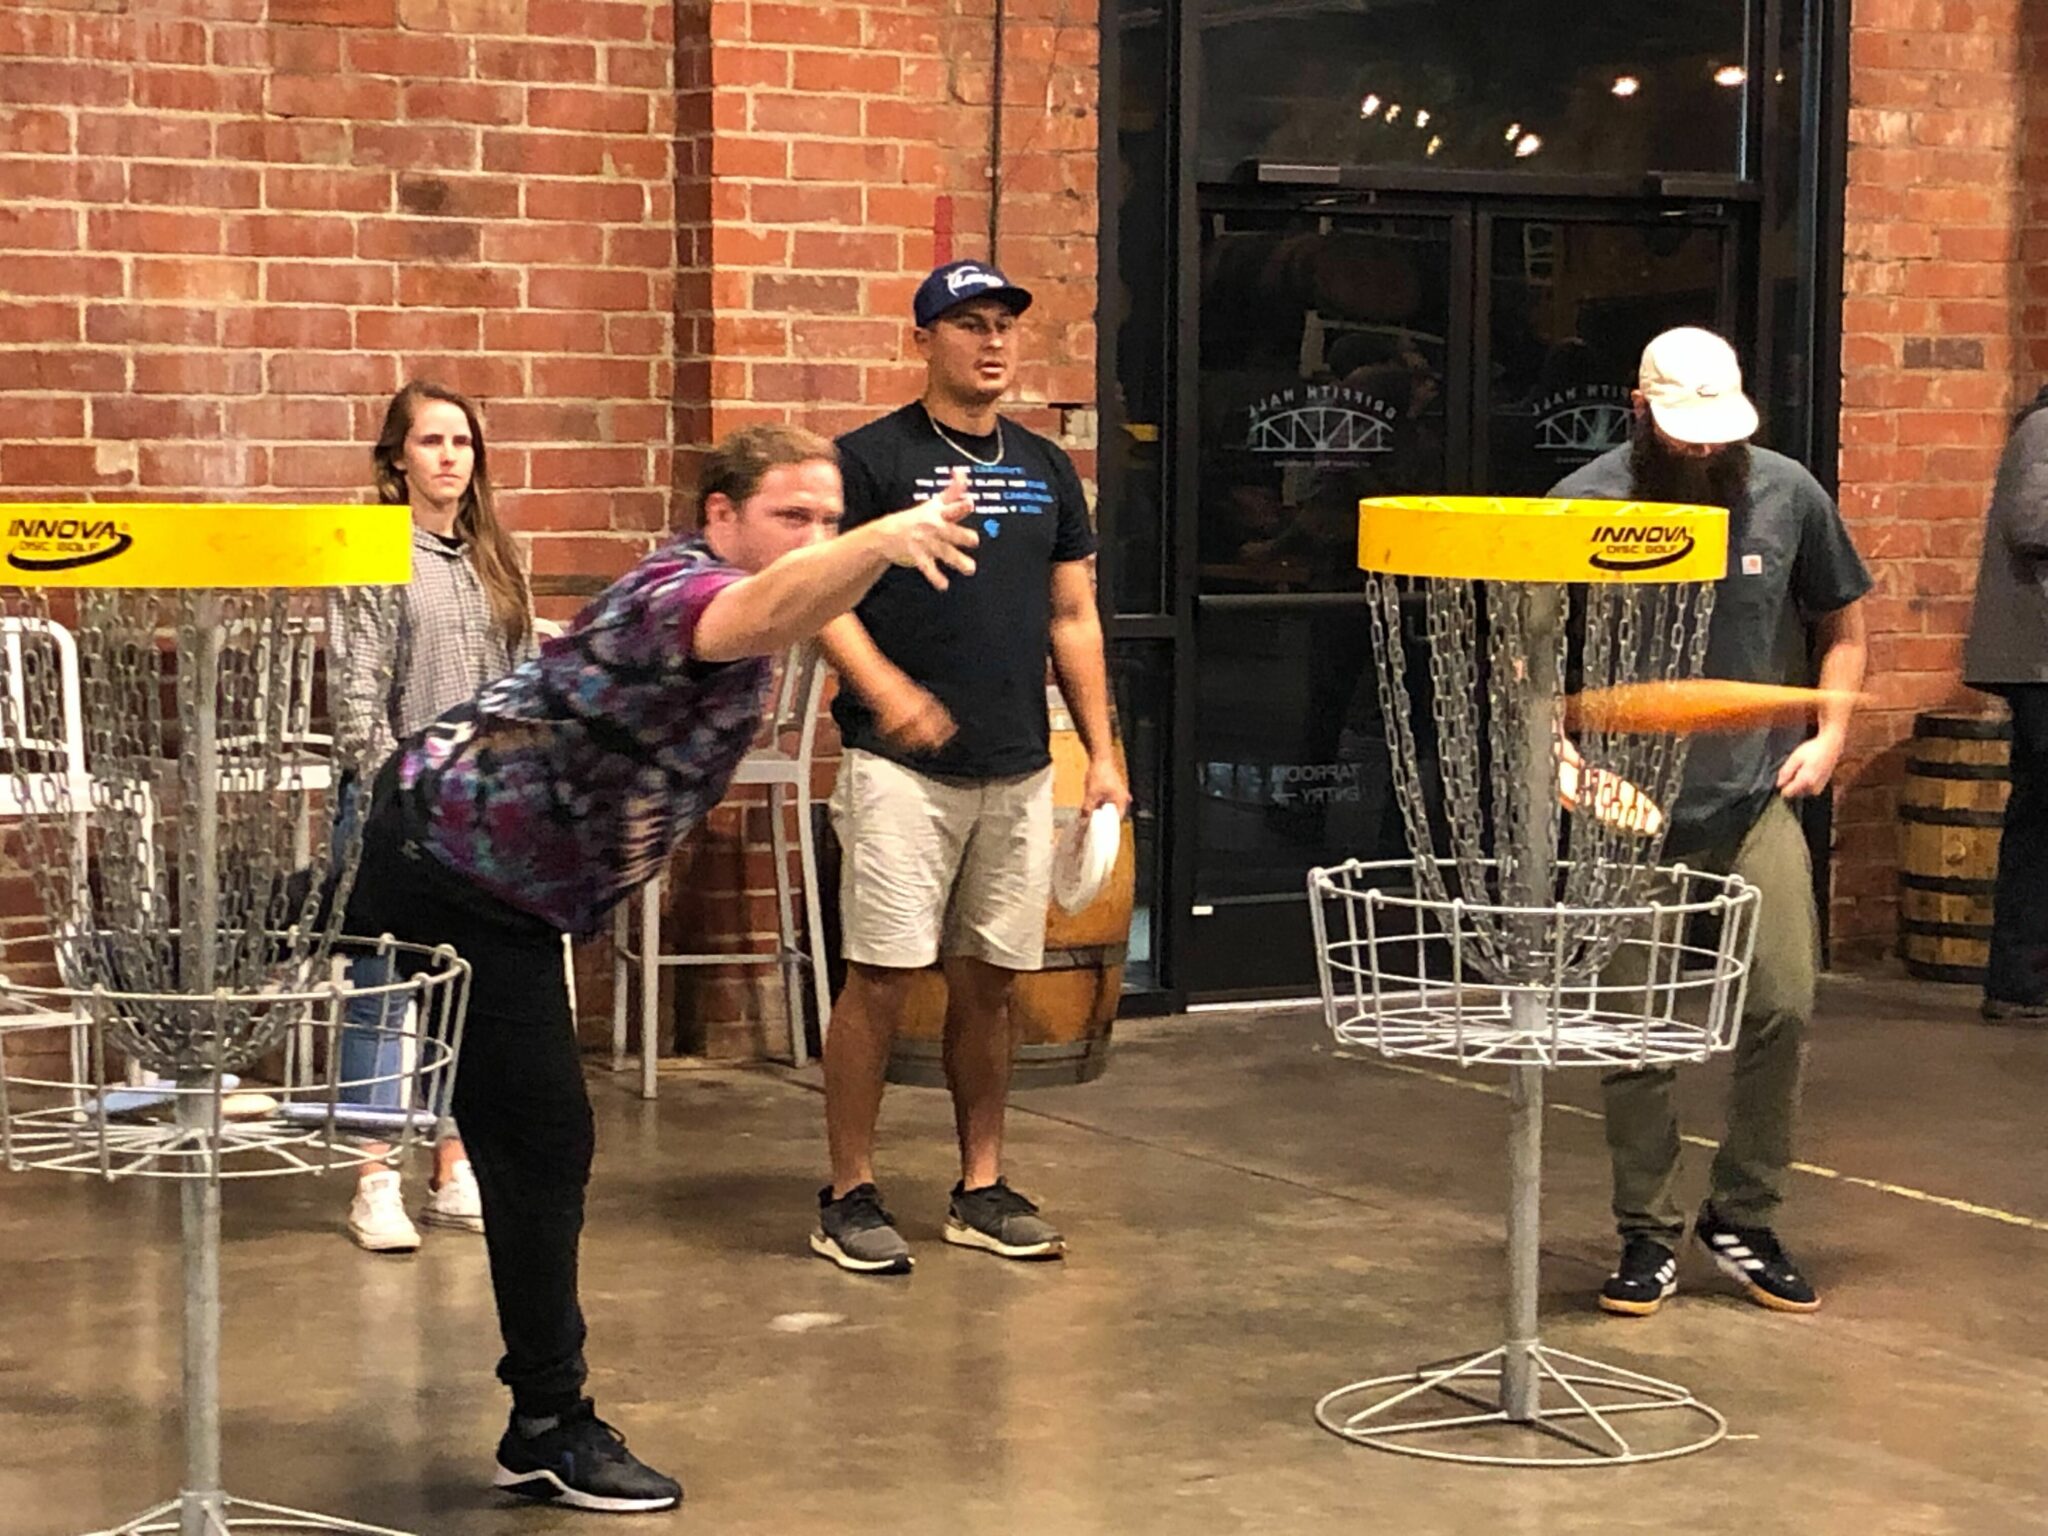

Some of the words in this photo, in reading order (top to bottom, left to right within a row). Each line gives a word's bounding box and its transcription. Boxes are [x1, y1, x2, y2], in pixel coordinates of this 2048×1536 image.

[8, 519, 116, 539] INNOVA
[1591, 526, 1688, 543] INNOVA
[1606, 544, 1640, 554] DISC
[1645, 544, 1677, 554] GOLF
